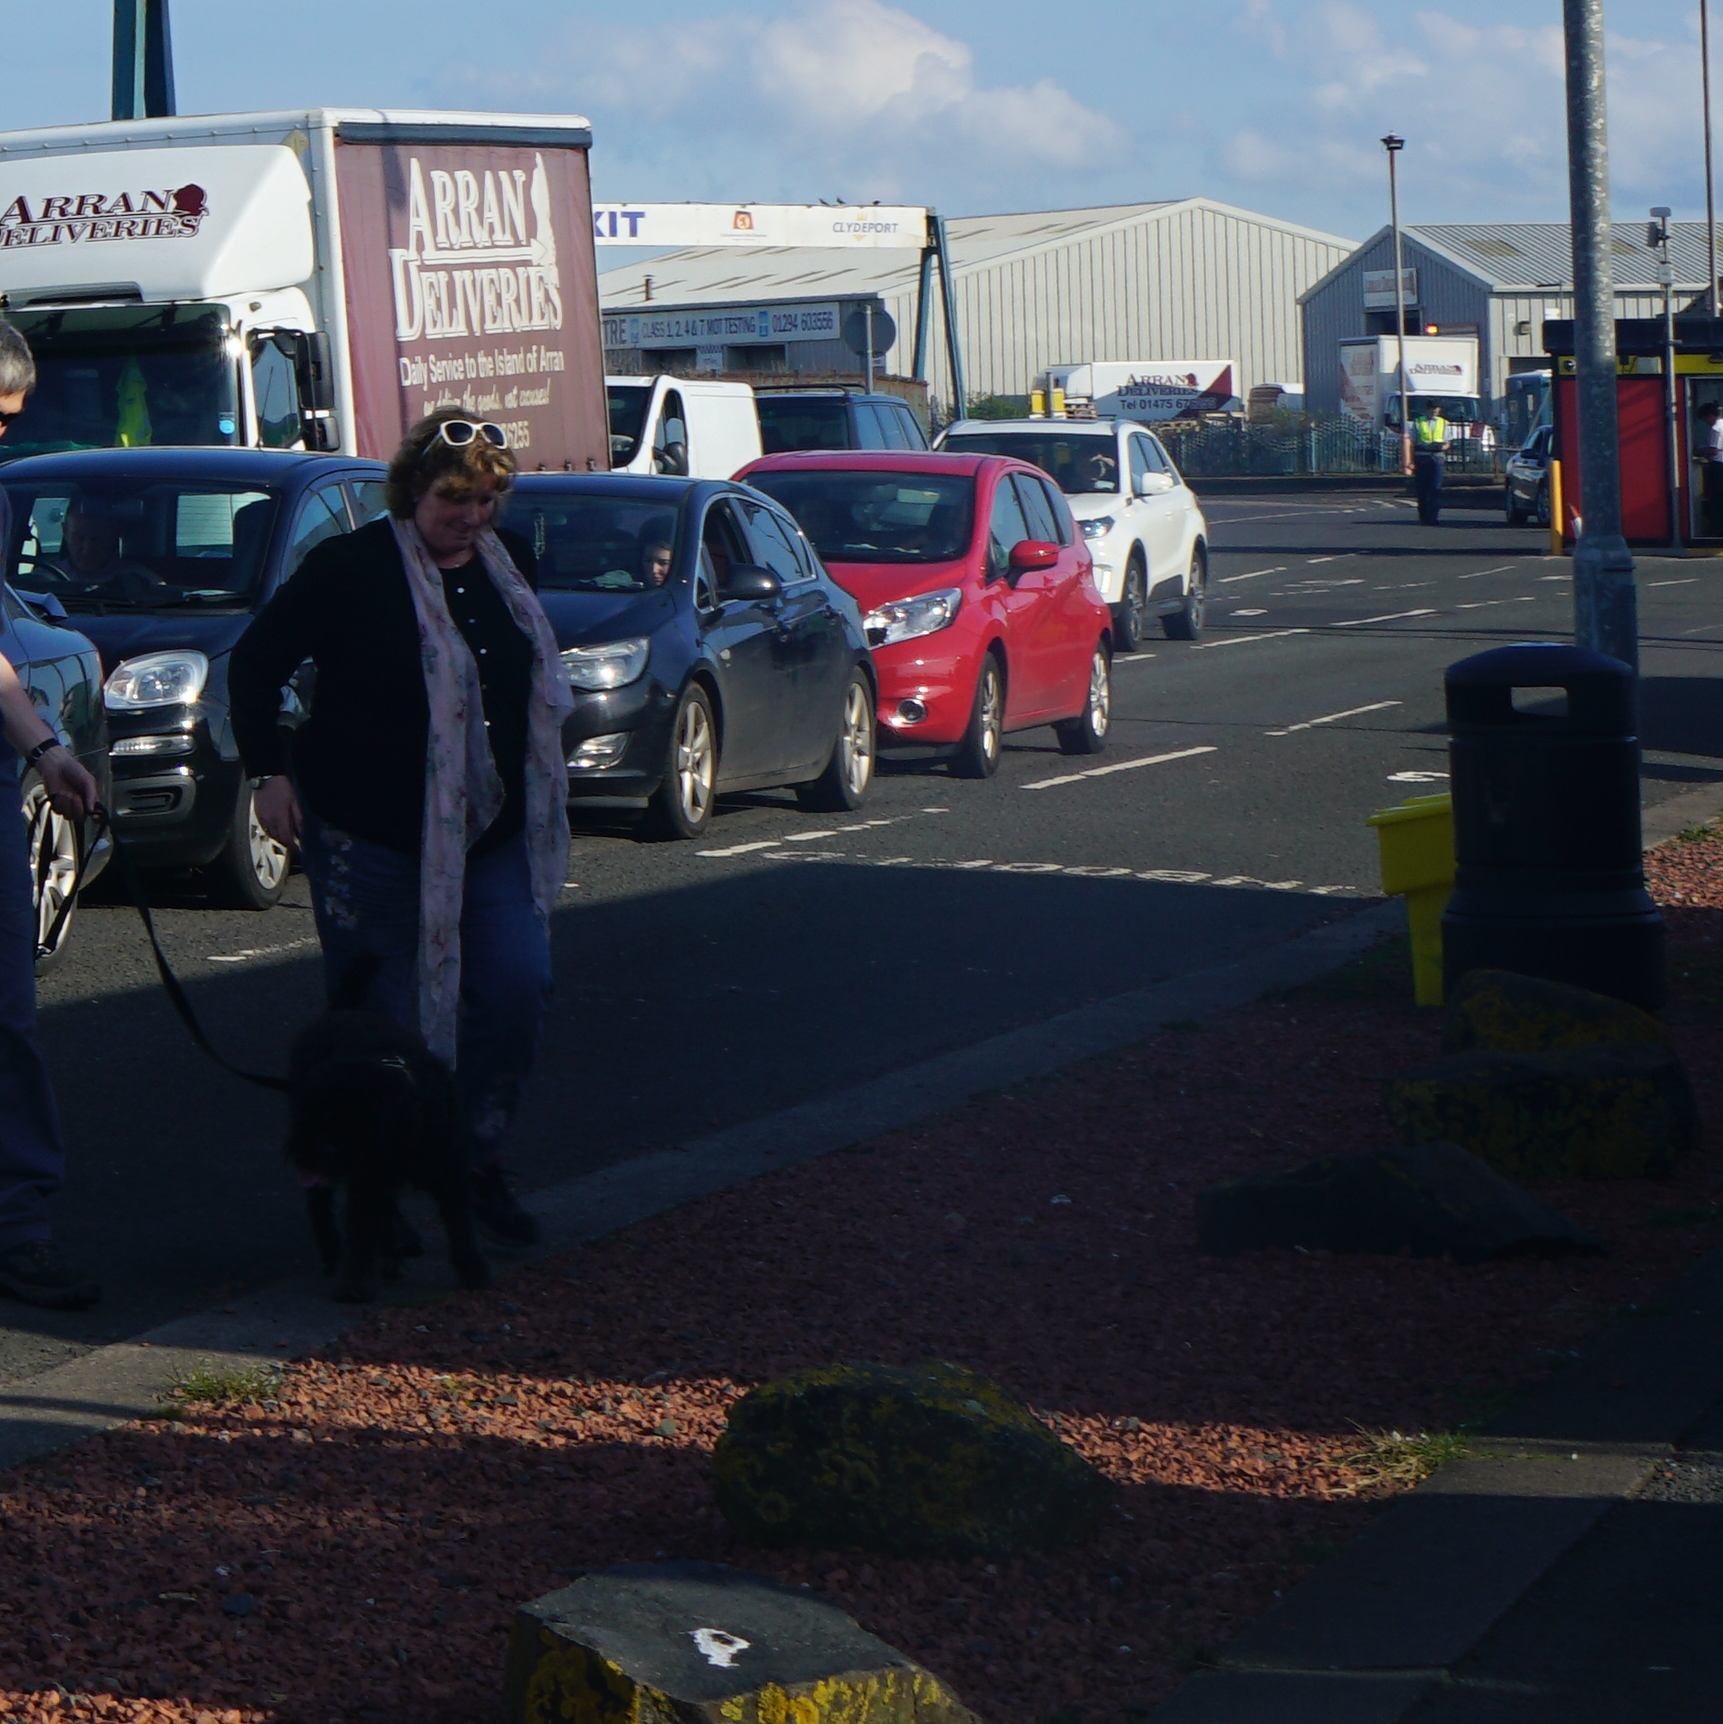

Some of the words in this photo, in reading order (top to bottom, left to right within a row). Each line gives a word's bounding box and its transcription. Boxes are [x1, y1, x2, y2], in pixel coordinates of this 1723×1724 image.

[408, 157, 527, 263] ARRAN
[594, 211, 646, 237] IT
[832, 221, 898, 234] CLYDEPORT
[388, 248, 563, 342] DELIVERIES
[602, 318, 627, 344] TRE
[706, 318, 723, 335] MOT
[724, 316, 755, 334] TESTING
[399, 355, 428, 391] Daily
[428, 352, 465, 383] Service
[465, 352, 477, 379] to
[477, 350, 494, 378] the
[495, 346, 525, 376] Island
[526, 344, 538, 373] of
[539, 344, 565, 372] Arran
[1126, 373, 1187, 386] ARRAN
[1119, 399, 1136, 409] Tel
[1139, 398, 1172, 409] 01475
